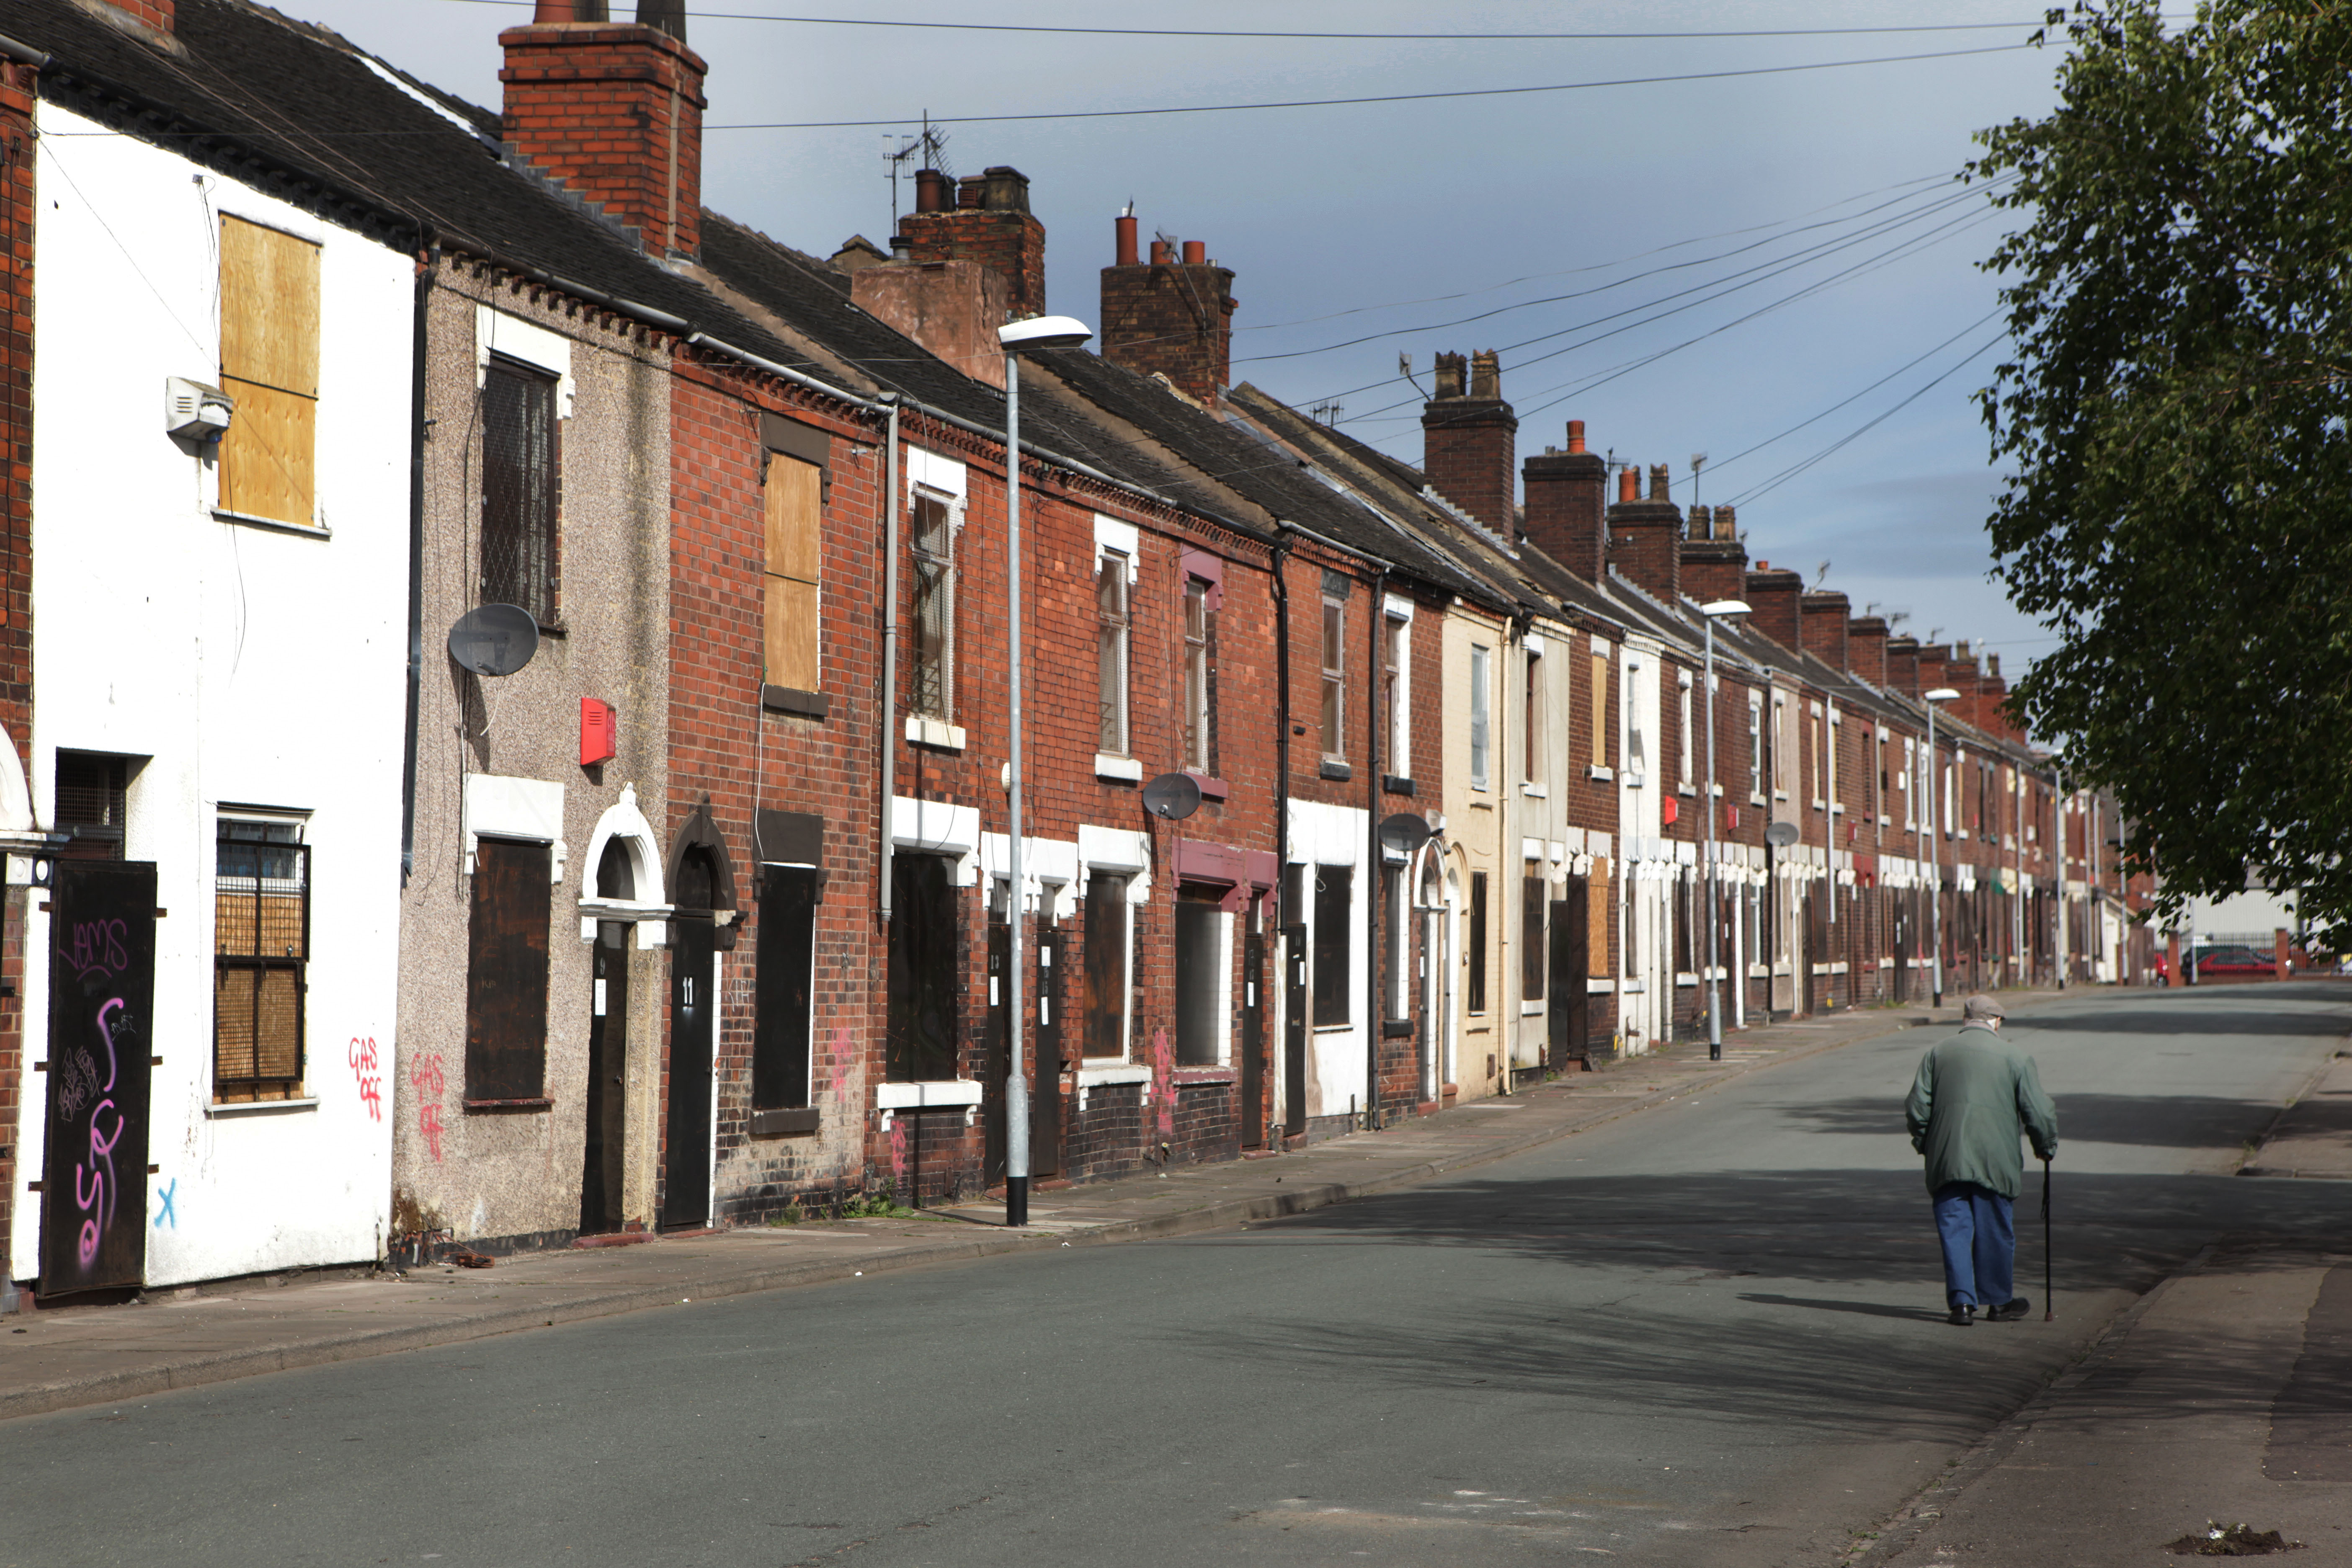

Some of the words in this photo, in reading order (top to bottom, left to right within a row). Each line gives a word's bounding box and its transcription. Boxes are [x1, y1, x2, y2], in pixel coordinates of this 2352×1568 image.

[600, 957, 606, 975] 9
[991, 954, 999, 970] 13
[683, 977, 693, 1004] 11
[349, 1037, 377, 1082] GAS
[411, 1053, 444, 1101] GAS
